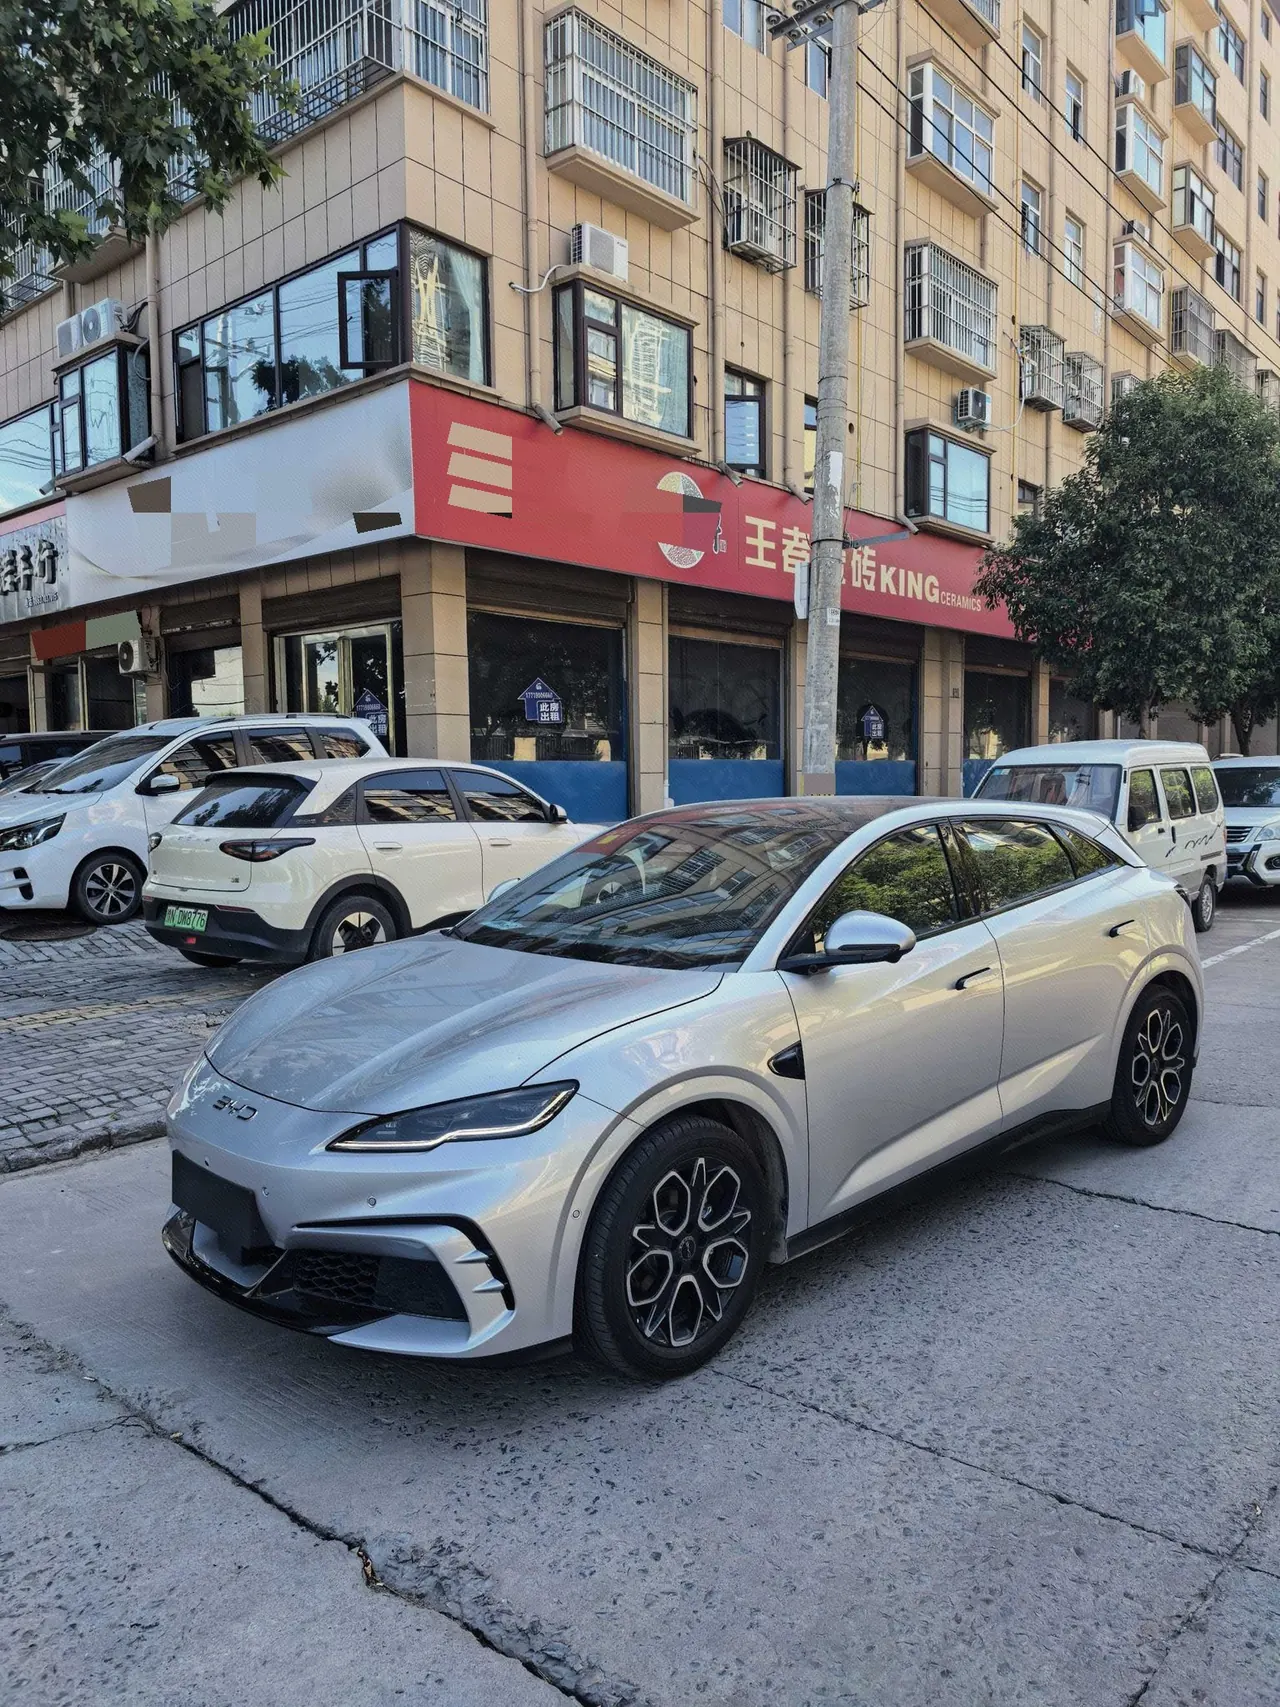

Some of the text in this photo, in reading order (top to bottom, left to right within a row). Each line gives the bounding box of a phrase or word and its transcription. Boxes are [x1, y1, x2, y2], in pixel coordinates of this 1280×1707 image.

[745, 515, 876, 592] 王者砖
[880, 564, 982, 612] KING CERAMICS
[540, 702, 559, 712] 此房
[540, 712, 560, 721] 出租
[212, 1095, 258, 1121] BYD
